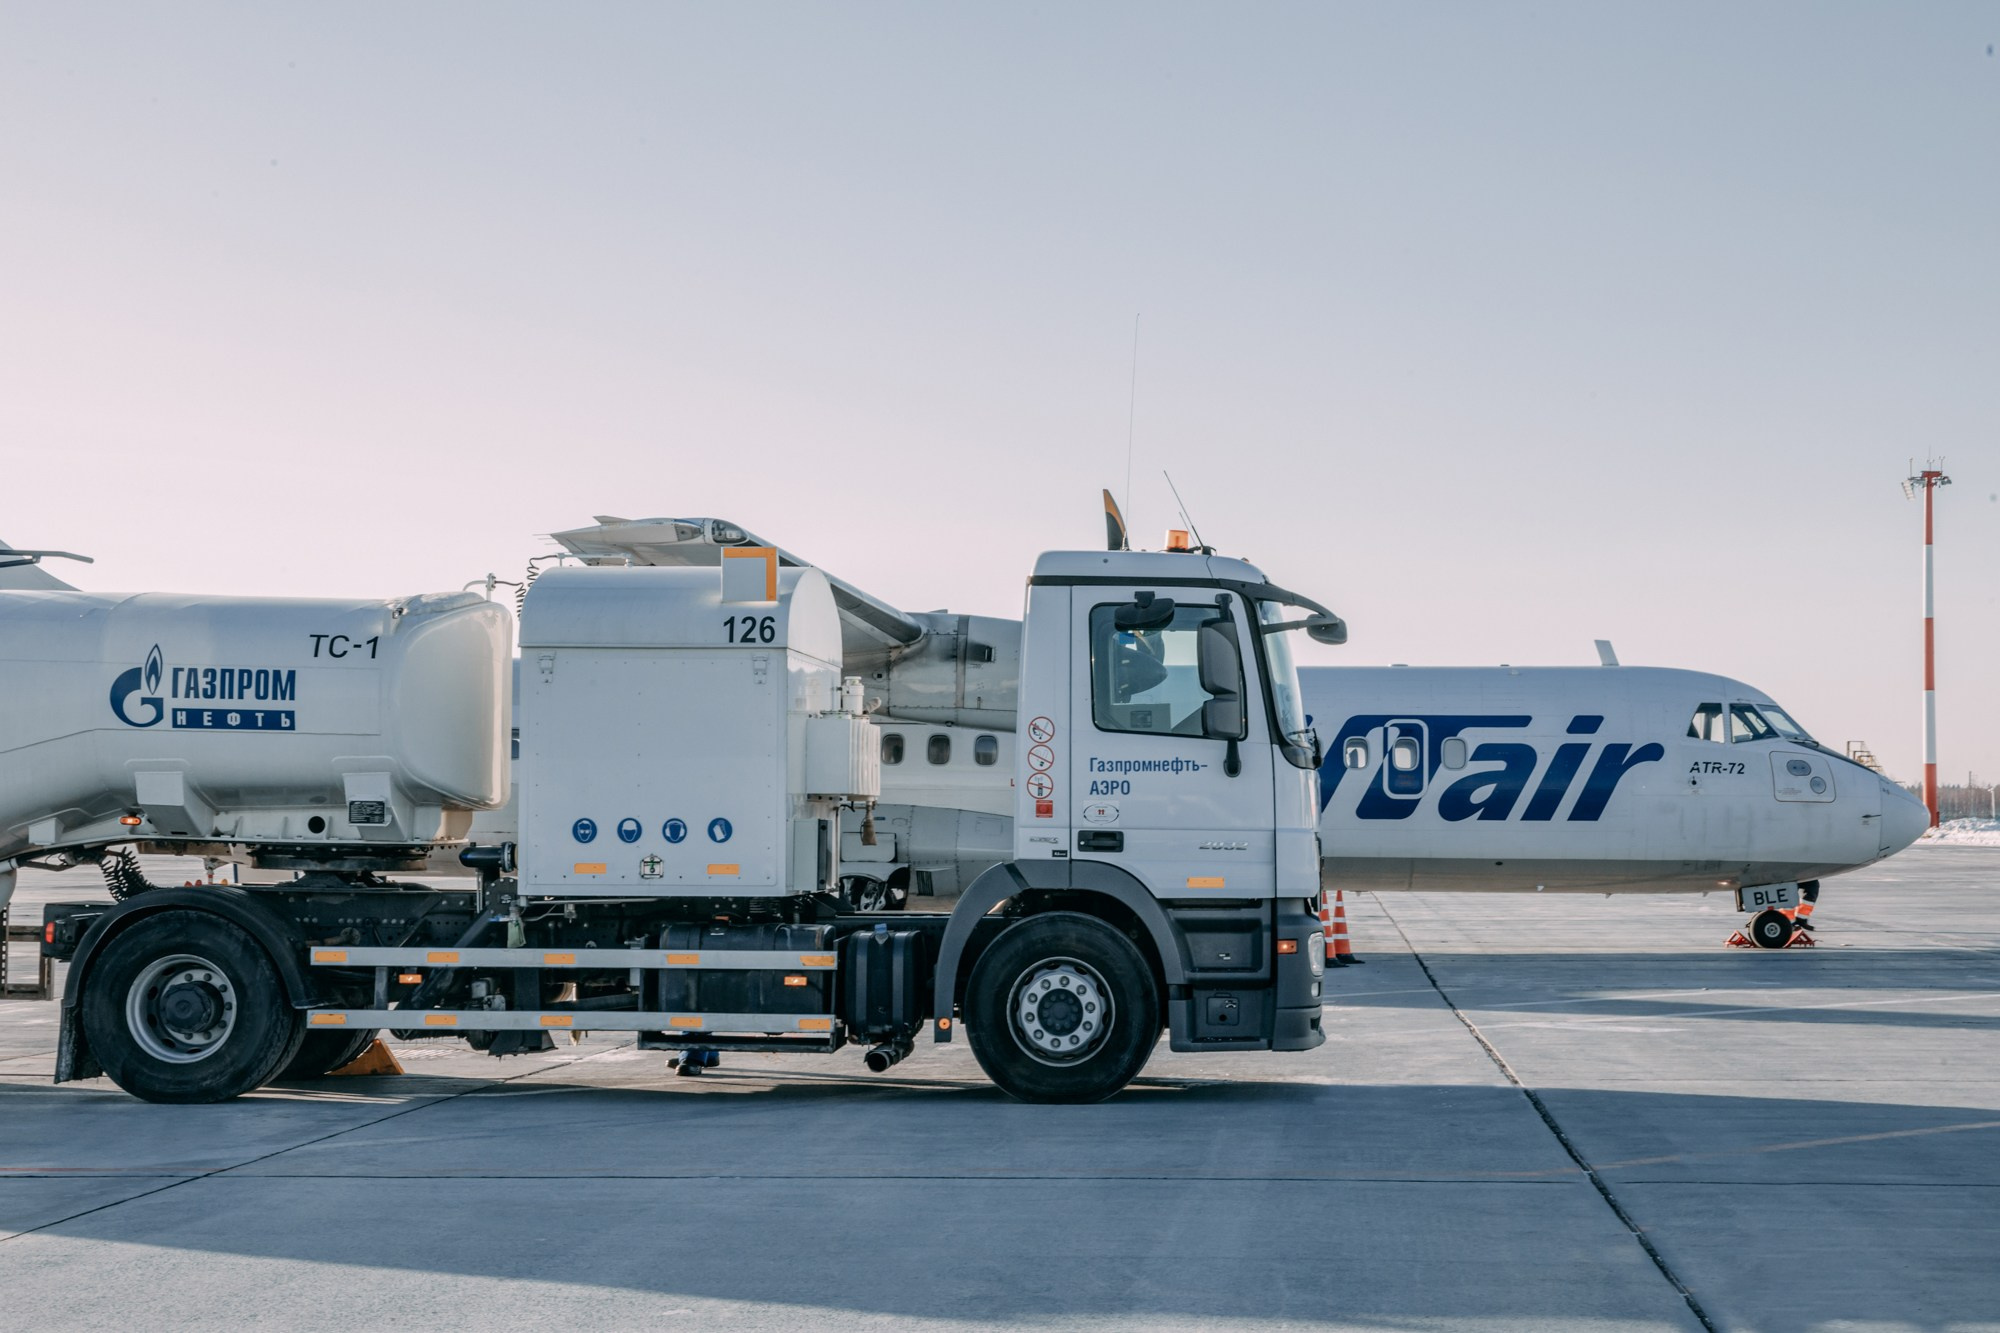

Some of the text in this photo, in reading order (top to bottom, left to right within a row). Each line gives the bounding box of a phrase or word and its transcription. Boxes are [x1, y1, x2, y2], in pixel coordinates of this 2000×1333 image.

[723, 615, 776, 643] 126
[309, 634, 380, 659] ТС-1
[171, 667, 297, 701] ГАЗПРОМ
[176, 711, 291, 727] НЕФТЬ
[1089, 757, 1208, 775] Газпромнефть-
[1689, 761, 1746, 775] ATR-72
[1089, 780, 1131, 795] АЭРО
[1753, 888, 1789, 905] BLE
